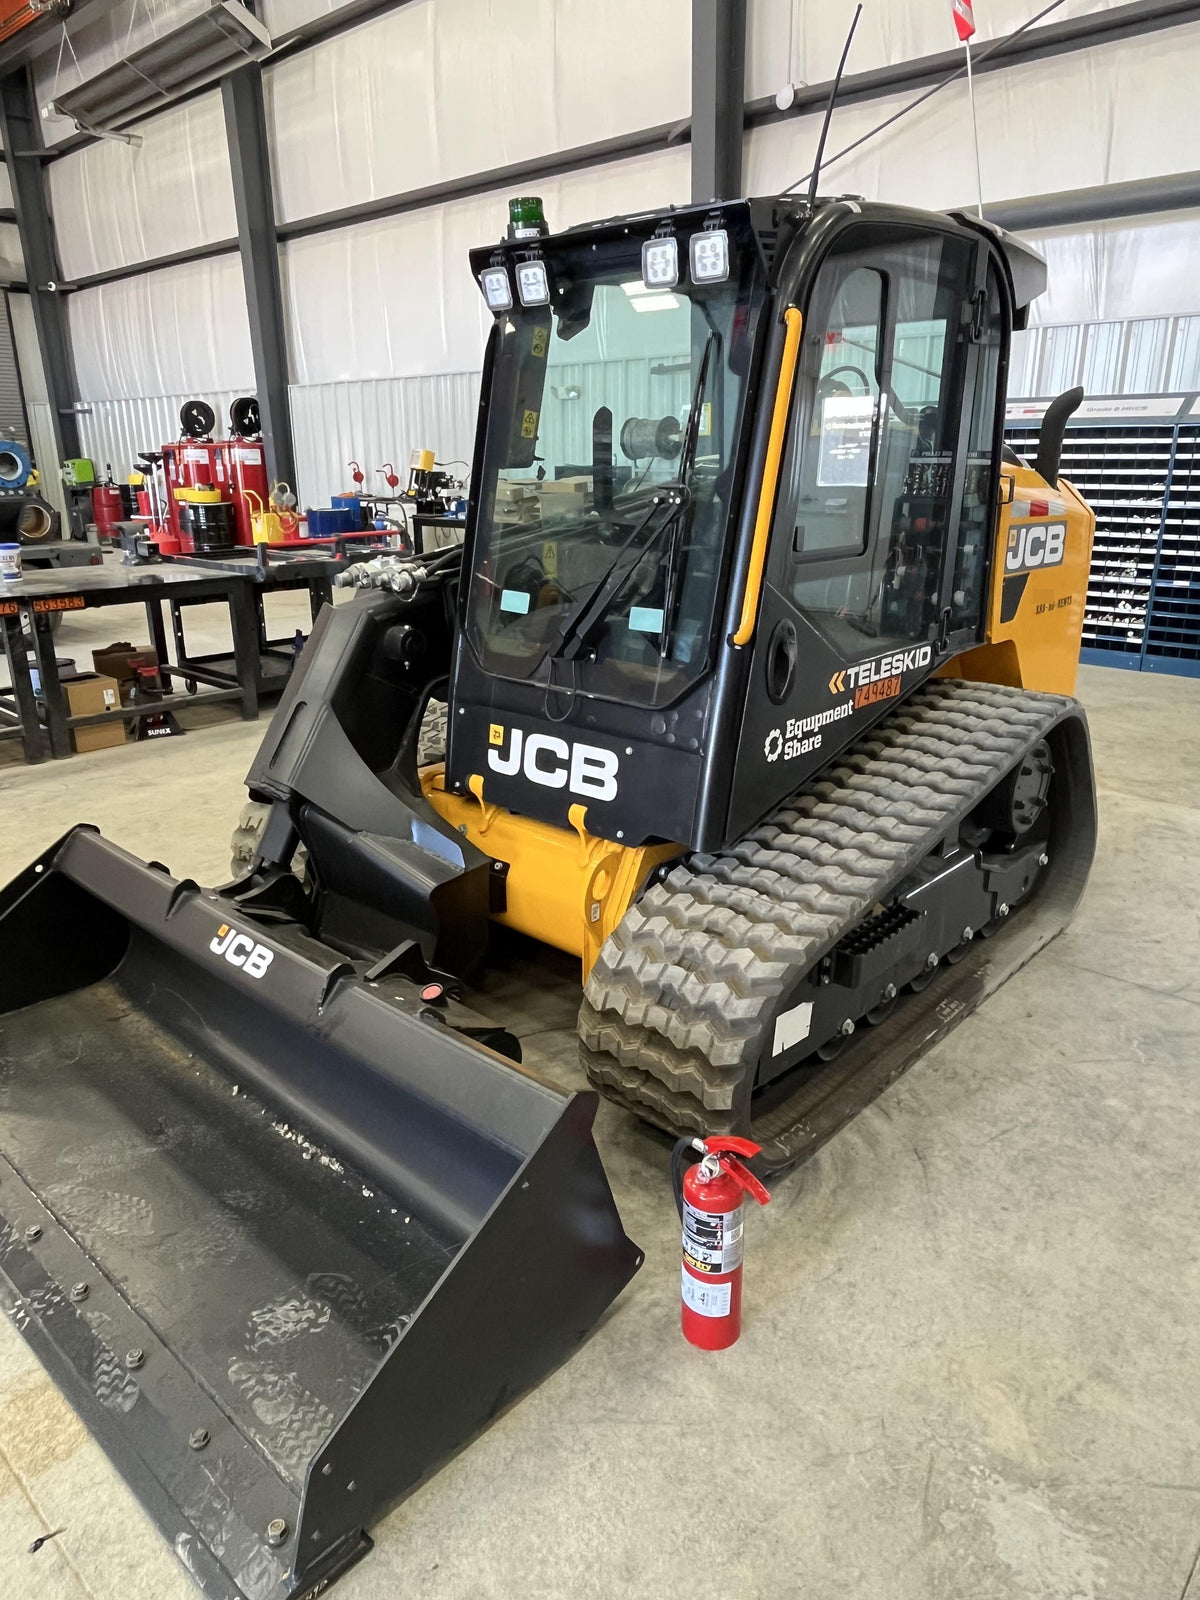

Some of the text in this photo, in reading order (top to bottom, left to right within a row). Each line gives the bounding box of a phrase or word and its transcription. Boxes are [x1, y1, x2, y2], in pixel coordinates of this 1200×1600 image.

[1006, 525, 1065, 570] JCB
[847, 645, 931, 688] TELESKID
[857, 676, 901, 706] 749487
[785, 699, 854, 741] Equipment
[487, 728, 619, 802] JCB
[784, 734, 822, 760] Share
[209, 928, 275, 979] JCB
